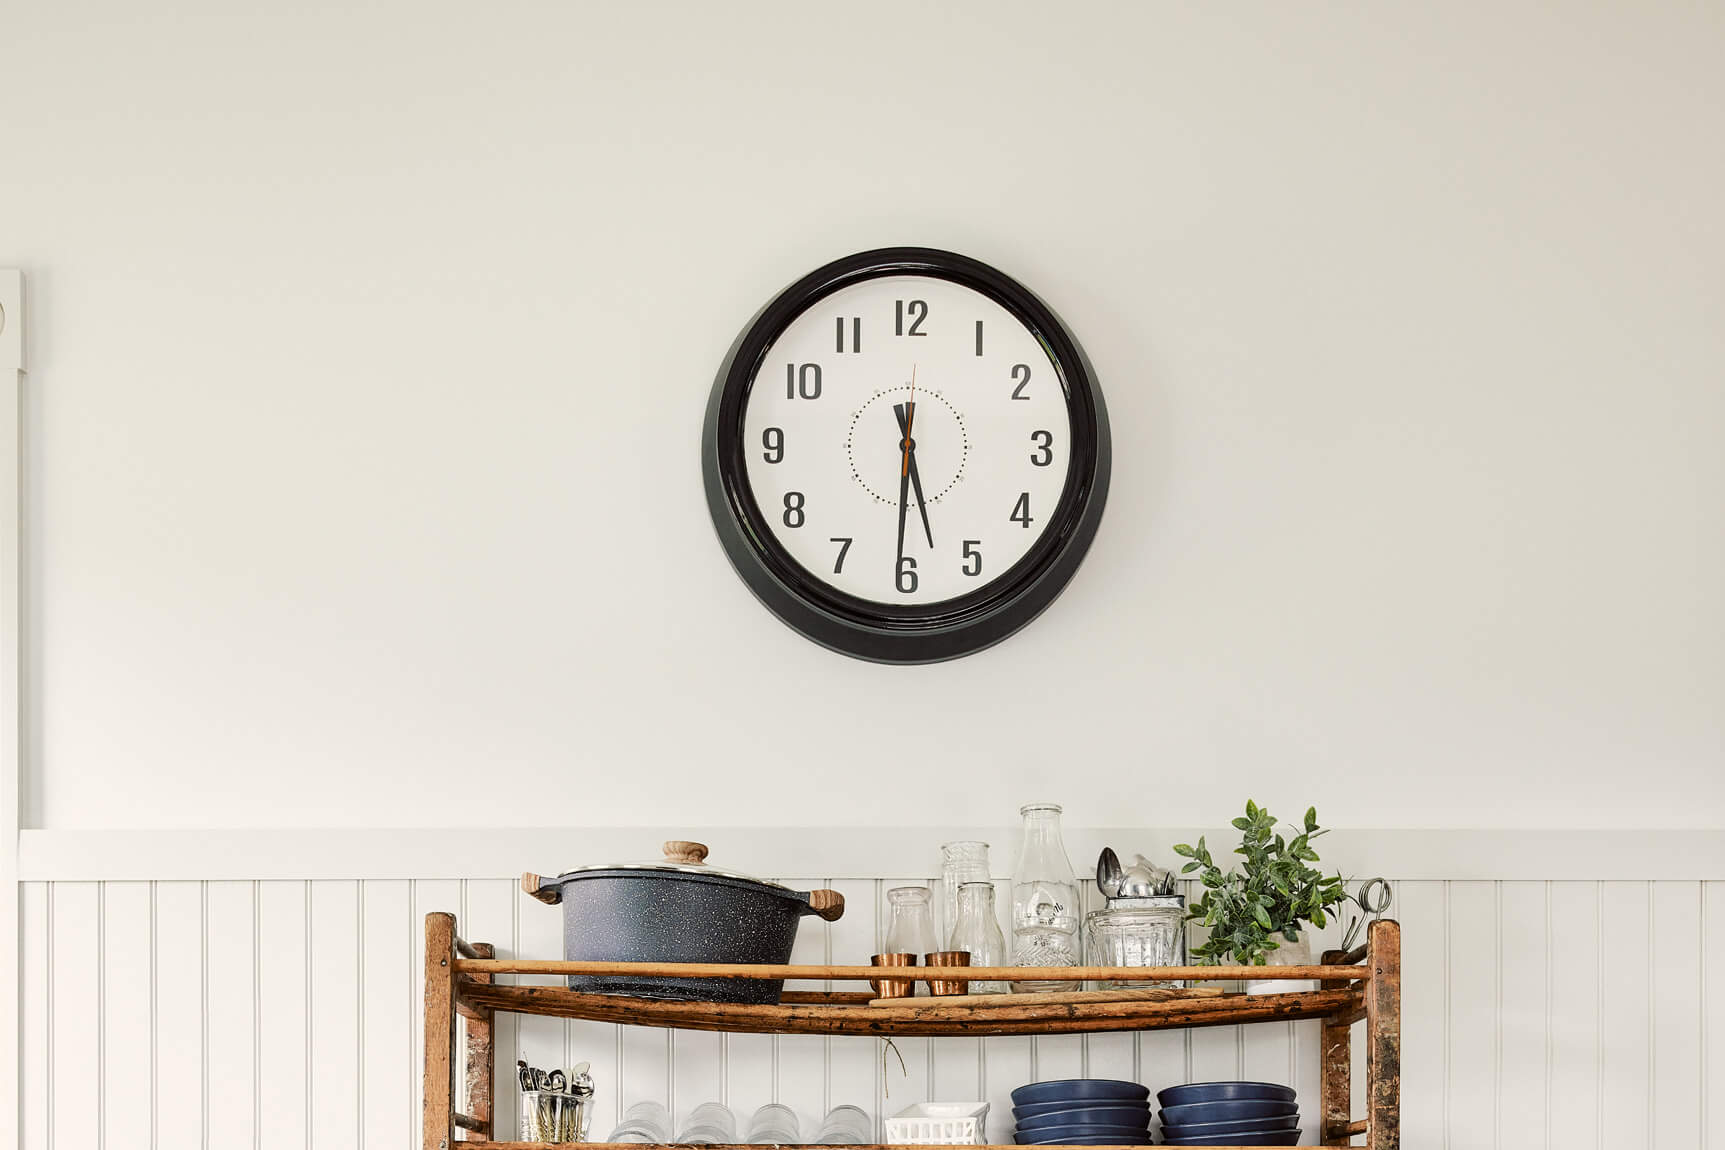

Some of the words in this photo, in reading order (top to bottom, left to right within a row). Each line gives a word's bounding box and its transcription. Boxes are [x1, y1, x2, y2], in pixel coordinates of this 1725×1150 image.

[836, 316, 861, 354] 11
[895, 299, 929, 337] 12
[975, 320, 984, 357] 1
[786, 363, 823, 400] 10
[1011, 363, 1032, 401] 2
[762, 427, 785, 465] 9
[1030, 430, 1053, 467] 3
[782, 491, 805, 529] 8
[1009, 492, 1034, 529] 4
[829, 537, 853, 574] 7
[961, 539, 982, 577] 5
[895, 556, 919, 594] 6
